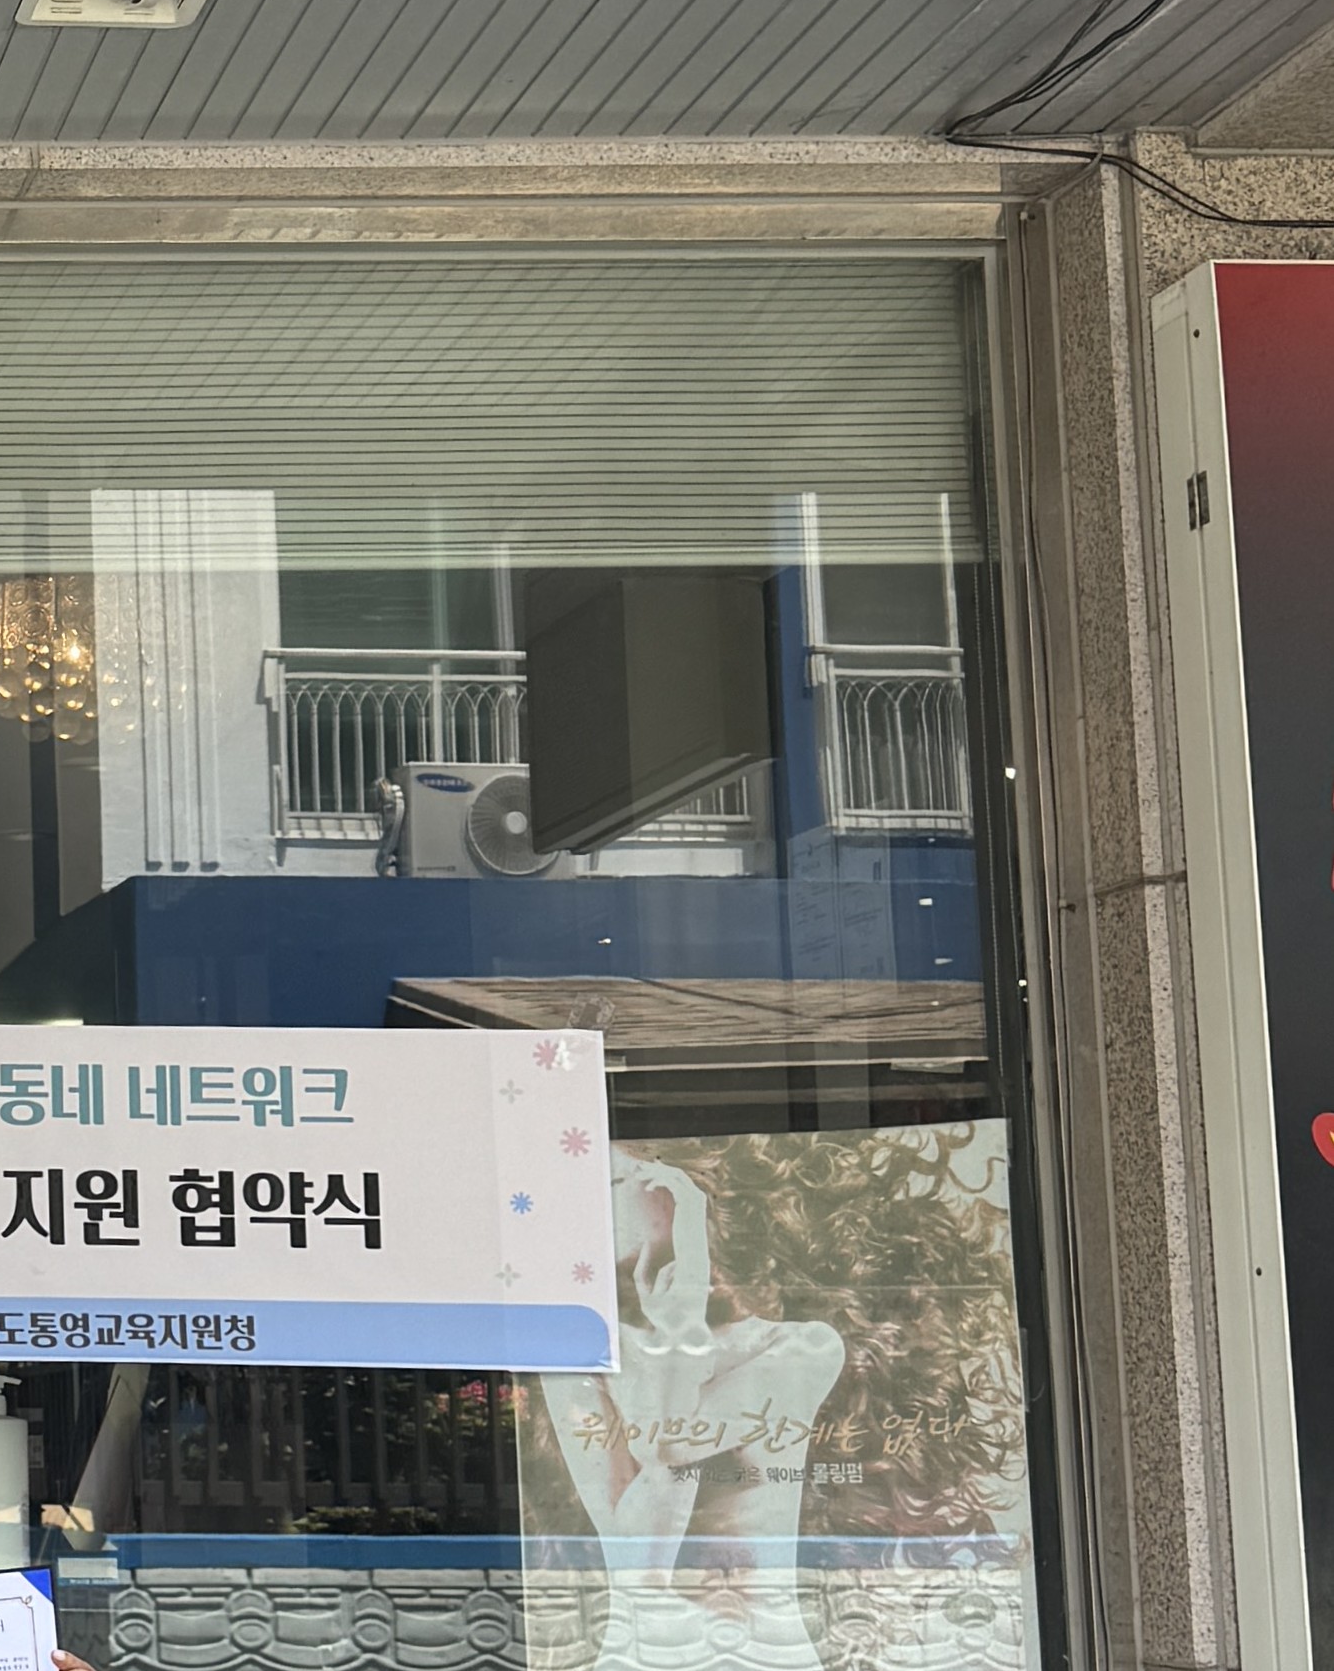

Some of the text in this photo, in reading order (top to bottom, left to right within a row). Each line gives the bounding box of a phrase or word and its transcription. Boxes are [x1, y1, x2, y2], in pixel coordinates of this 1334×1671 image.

[127, 1063, 355, 1127] 네트워크
[0, 1167, 141, 1247] 지원
[168, 1168, 383, 1250] 협약식
[572, 1396, 976, 1456] 웨이브의 한계는 없다
